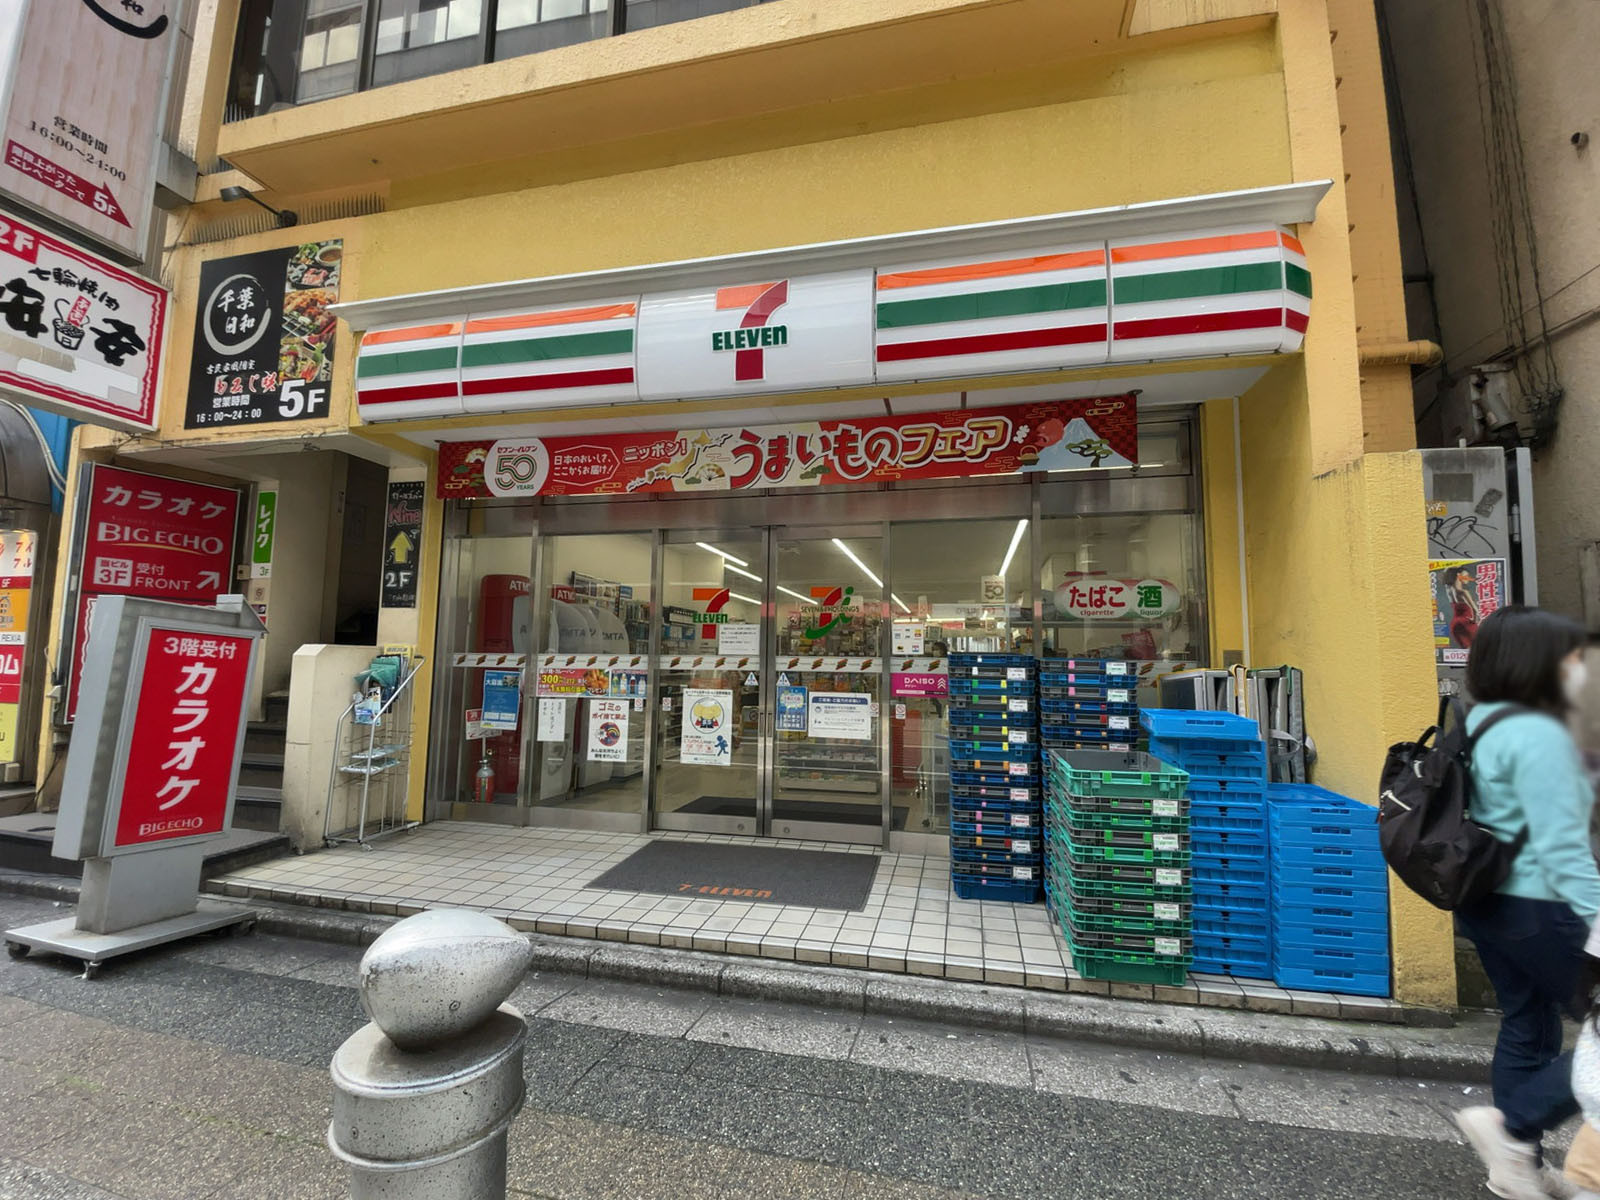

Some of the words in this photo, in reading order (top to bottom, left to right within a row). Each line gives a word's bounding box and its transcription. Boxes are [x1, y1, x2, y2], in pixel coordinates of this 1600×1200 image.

[54, 116, 108, 155] 営業時間
[93, 191, 117, 216] 5F
[217, 286, 255, 313] 千葉
[225, 313, 256, 335] 日和
[212, 394, 250, 409] 営業時間
[279, 379, 325, 418] 5F
[102, 485, 227, 519] カラオケ
[257, 504, 270, 548] レイク
[97, 521, 150, 542] BIG
[155, 531, 224, 555] ECHO
[100, 569, 128, 584] 3F
[136, 563, 164, 576] 受付
[385, 571, 412, 588] 2F
[135, 577, 191, 591] FRONT
[1069, 585, 1126, 608] たばこ
[1137, 585, 1162, 608] 酒
[1080, 609, 1115, 617] cigarette
[163, 637, 238, 661] 3階受付
[904, 677, 934, 685] DAISO
[599, 702, 622, 712] ゴミの
[156, 662, 217, 811] カラオケ
[139, 822, 165, 837] BIG
[167, 816, 203, 830] ECHO
